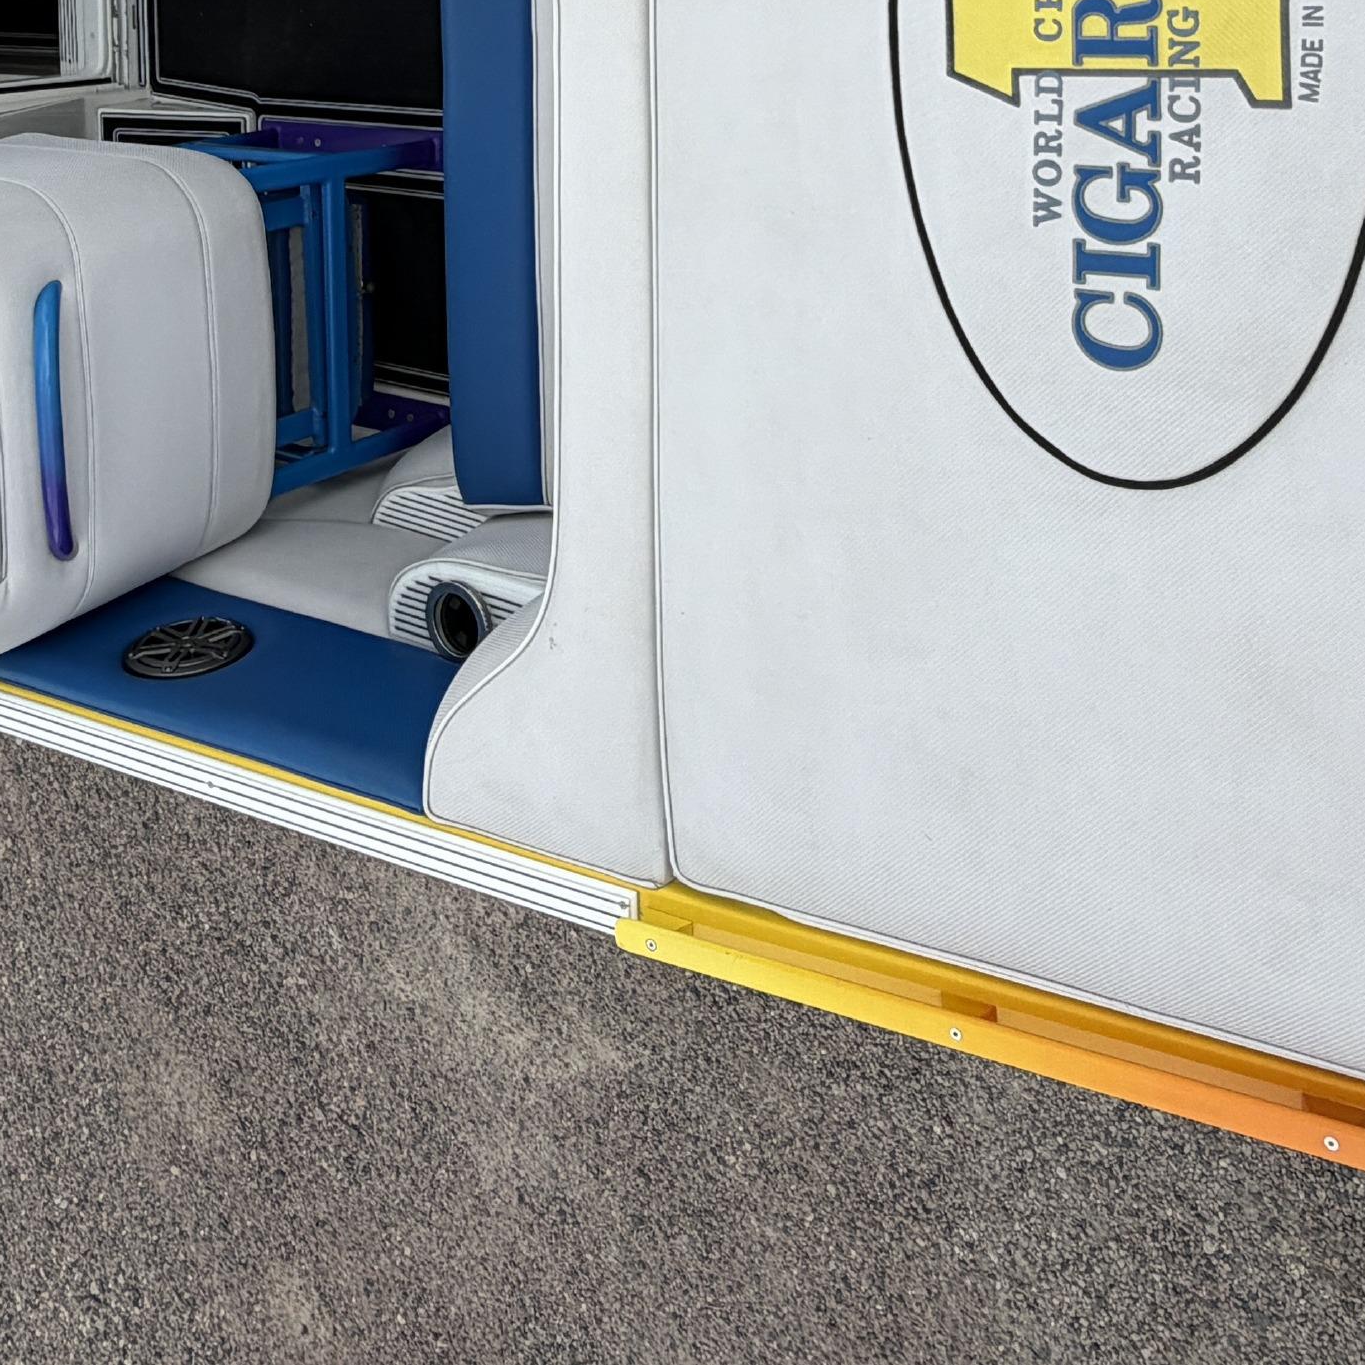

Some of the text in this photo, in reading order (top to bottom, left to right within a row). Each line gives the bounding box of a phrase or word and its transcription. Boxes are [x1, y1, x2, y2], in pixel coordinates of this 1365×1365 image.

[1302, 4, 1325, 27] IN
[1168, 5, 1202, 184] RACING
[1297, 39, 1325, 104] MADE
[1032, 69, 1065, 226] WORLD
